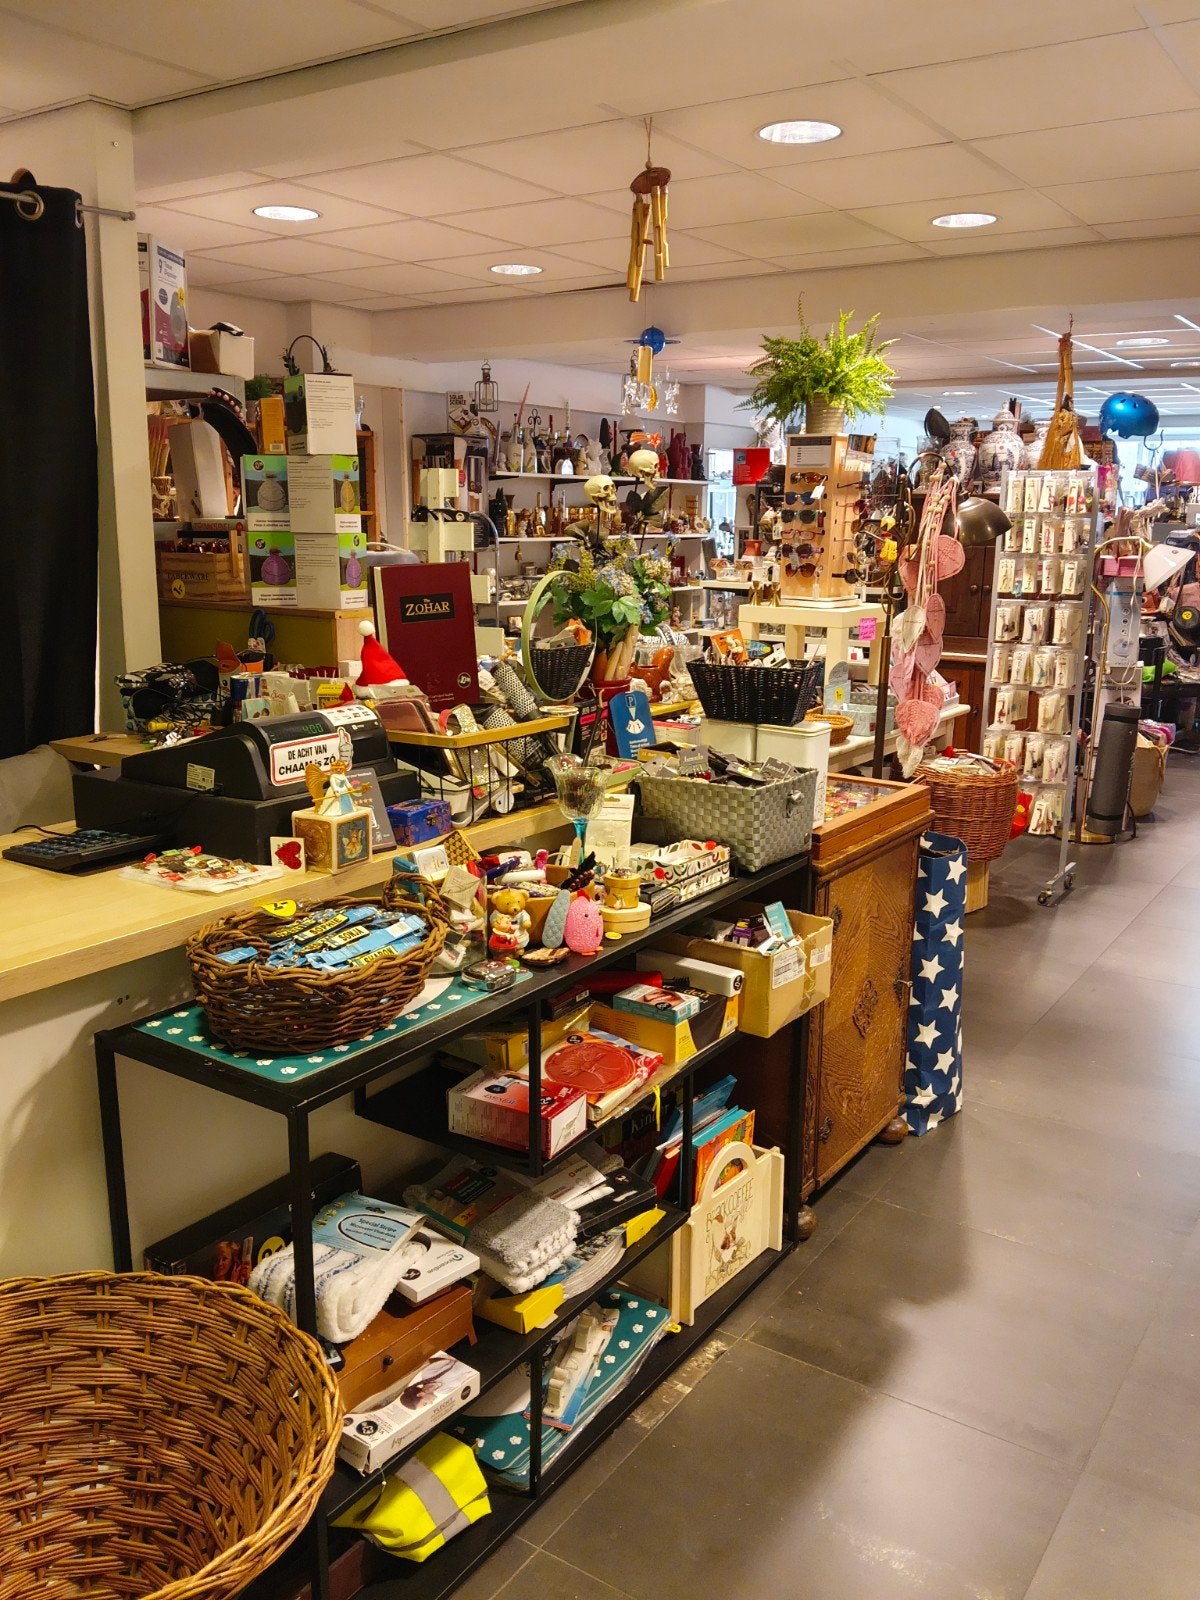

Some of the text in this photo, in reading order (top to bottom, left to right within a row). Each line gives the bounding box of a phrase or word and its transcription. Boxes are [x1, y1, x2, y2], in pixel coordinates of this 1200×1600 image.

[405, 602, 450, 616] ZOHAR
[287, 744, 328, 761] DE ACHT VAN
[309, 917, 342, 935] SOPHIE
[338, 927, 365, 942] SONJA
[358, 1217, 397, 1233] Special Stripe
